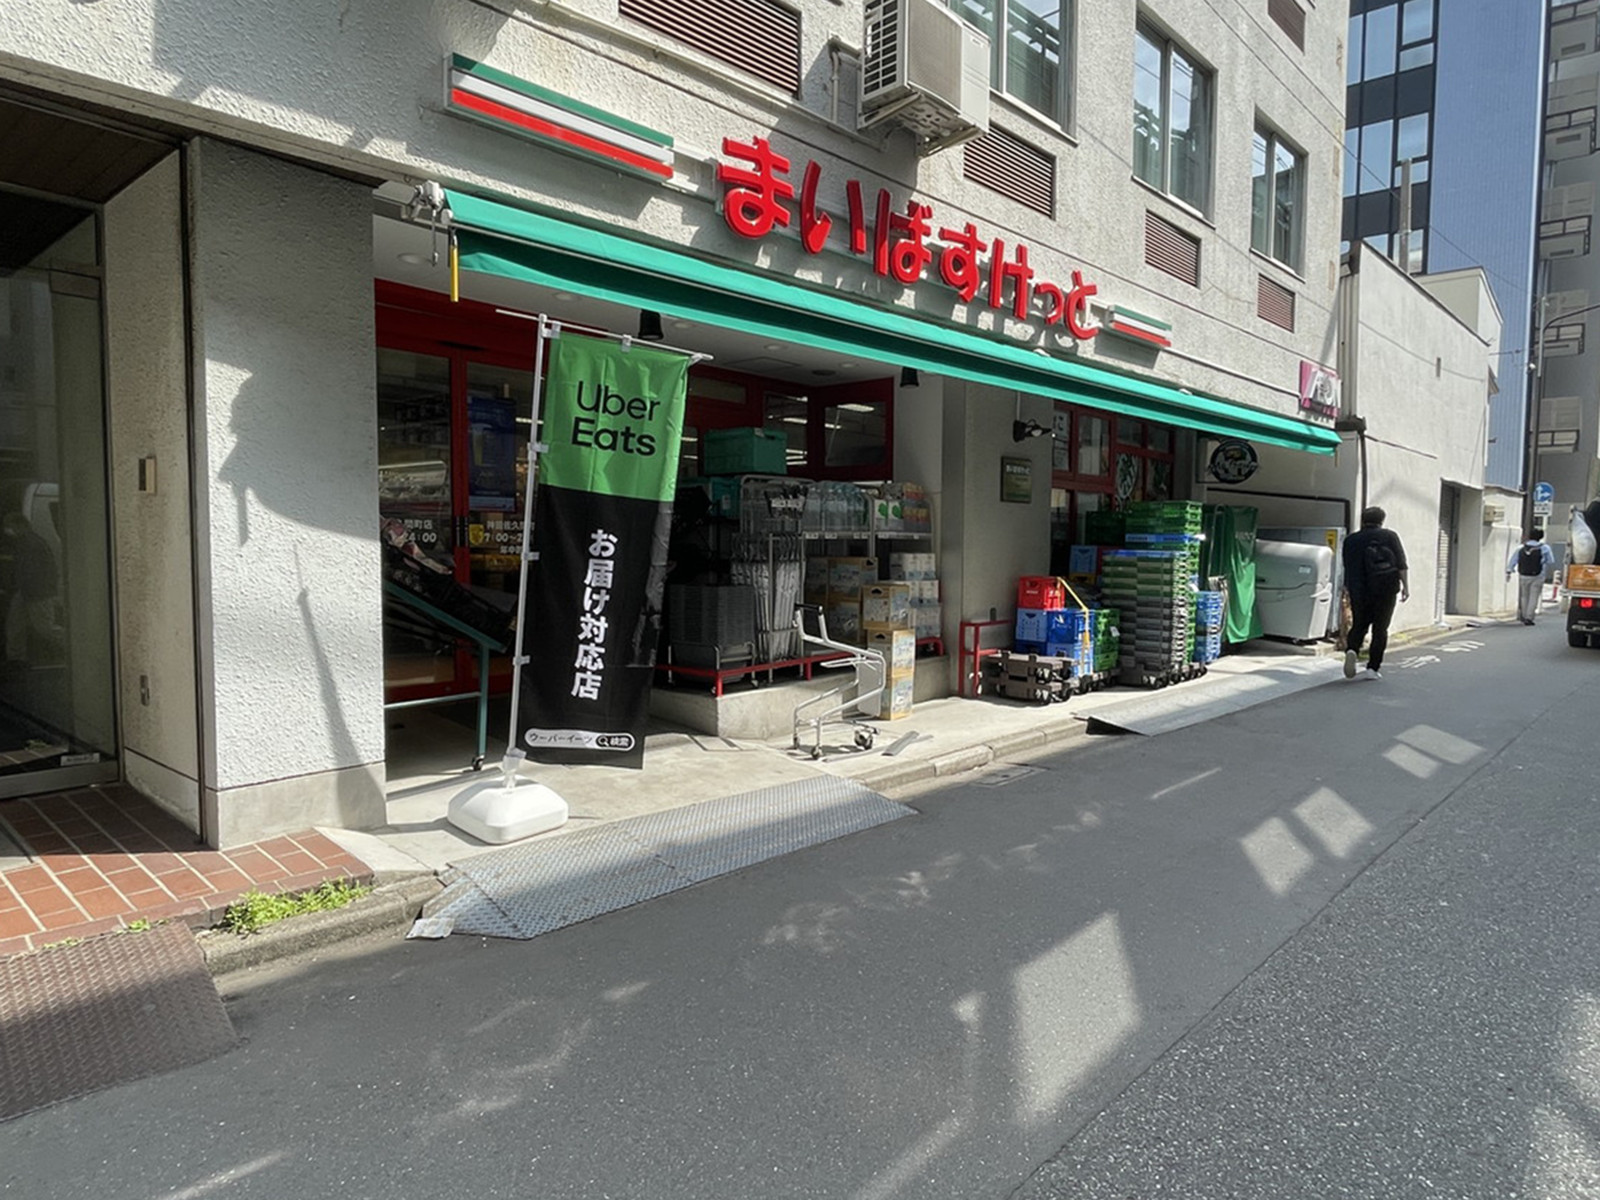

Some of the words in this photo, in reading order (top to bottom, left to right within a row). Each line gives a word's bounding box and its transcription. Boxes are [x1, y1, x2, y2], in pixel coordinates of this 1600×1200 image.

[717, 136, 1098, 340] まいばすけっと
[577, 381, 660, 421] Uber
[571, 416, 656, 456] Eats
[571, 529, 618, 700] お届け対応店
[529, 732, 593, 744] ウーバーイーツ
